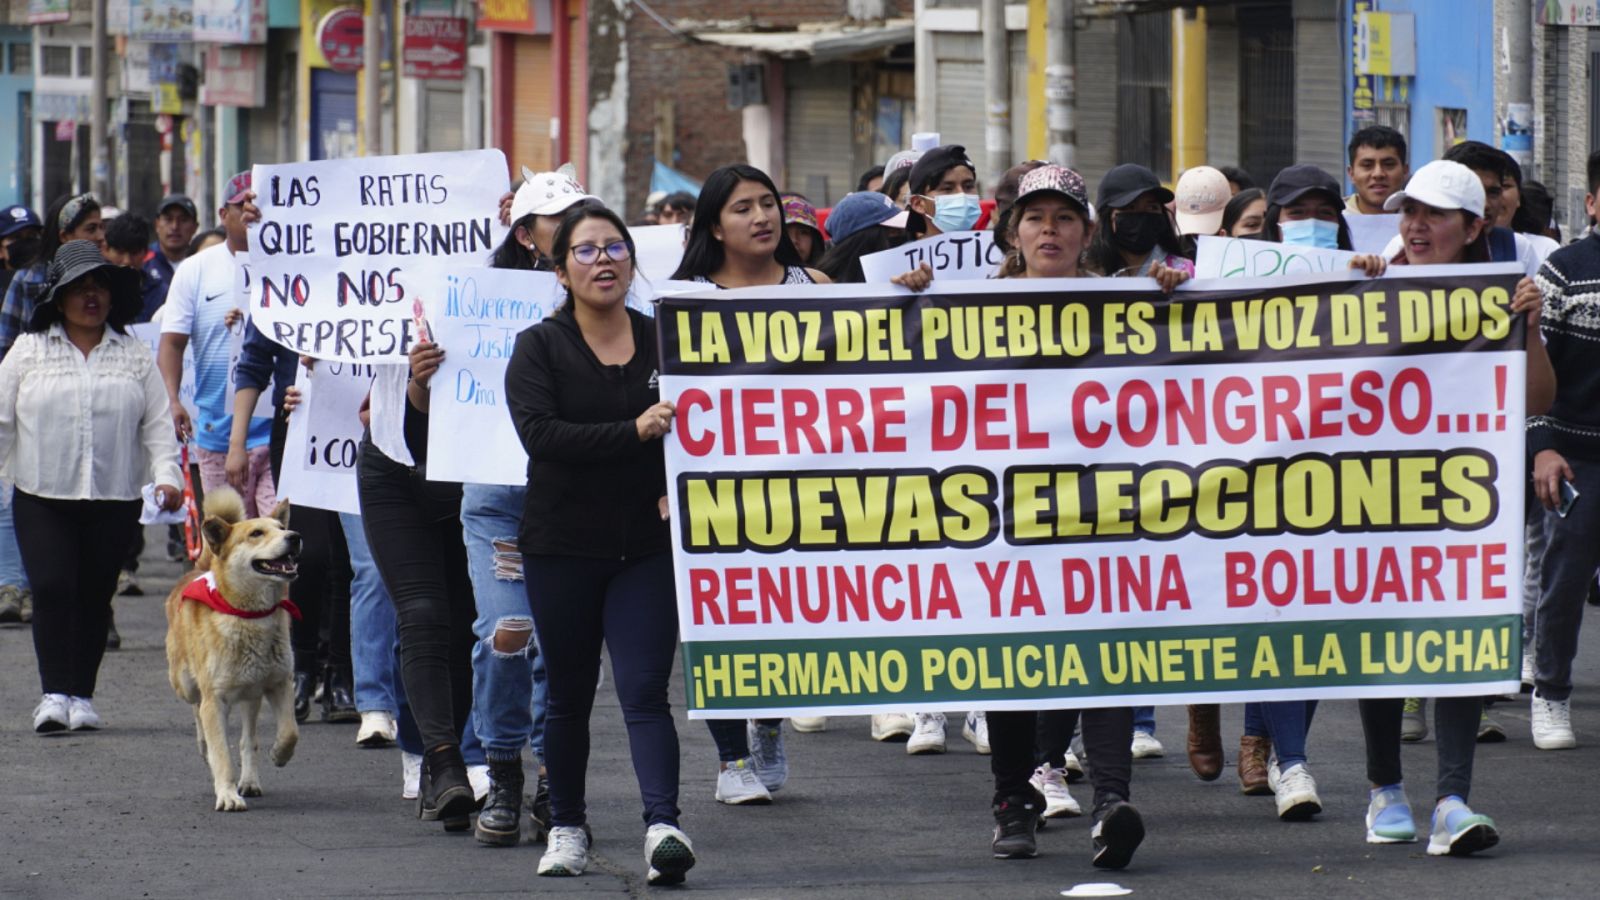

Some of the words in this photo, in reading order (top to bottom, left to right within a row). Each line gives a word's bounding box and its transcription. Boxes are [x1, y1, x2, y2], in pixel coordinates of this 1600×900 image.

[406, 18, 463, 38] DENTAL
[270, 175, 321, 207] LAS
[359, 173, 448, 206] RATAS
[259, 220, 316, 255] QUE
[334, 217, 492, 257] GOBIERNAN
[260, 273, 311, 308] NO
[337, 267, 405, 307] NOS
[676, 310, 731, 363] LA
[736, 310, 826, 364] VOZ
[833, 308, 913, 363] DEL
[920, 302, 1092, 360] PUEBLO
[1103, 302, 1158, 356] ES
[1168, 301, 1223, 353] LA
[1231, 296, 1321, 351] VOZ
[1330, 291, 1390, 347] DE
[1398, 286, 1512, 343] DIOS
[456, 368, 496, 406] Dina
[675, 386, 908, 457] CIERRE
[930, 383, 1051, 452] DEL
[685, 472, 991, 547] NUEVAS
[1013, 454, 1491, 539] ELECCIONES
[689, 562, 963, 625] RENUNCIA
[974, 560, 1047, 618] YA
[1061, 553, 1192, 615] DINA
[1225, 543, 1508, 608] BOLUARTE
[693, 649, 908, 709] ¡HERMANO
[921, 643, 1090, 692] POLICIA
[1099, 637, 1238, 685] UNETE
[1250, 635, 1281, 678] A
[1293, 633, 1347, 676] LA
[1360, 628, 1511, 675] LUCHA!
